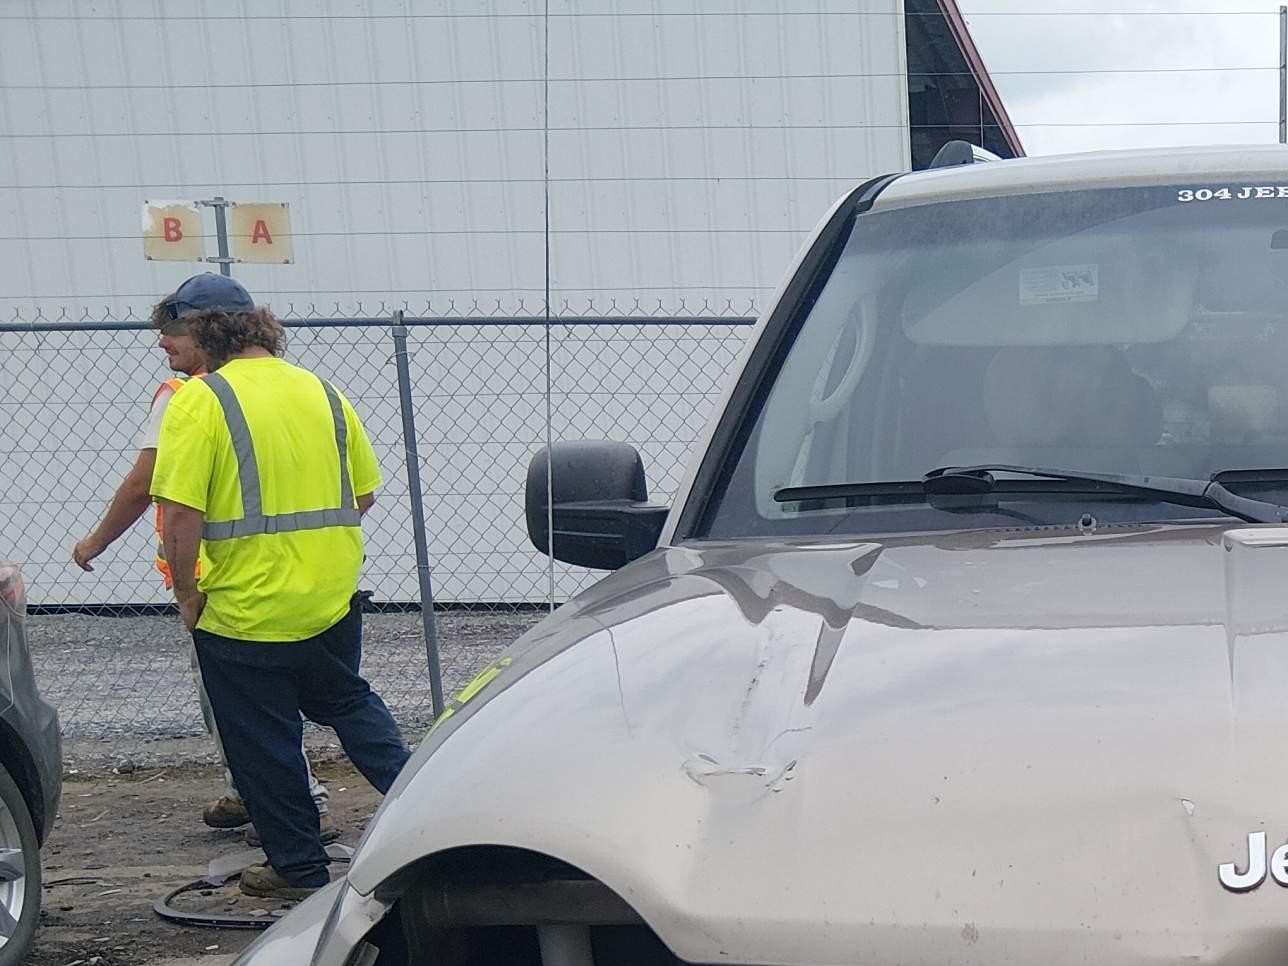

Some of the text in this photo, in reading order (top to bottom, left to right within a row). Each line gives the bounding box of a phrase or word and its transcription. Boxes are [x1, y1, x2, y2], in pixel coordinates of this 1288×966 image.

[1177, 188, 1232, 202] 304
[163, 217, 184, 243] B
[251, 219, 273, 245] A
